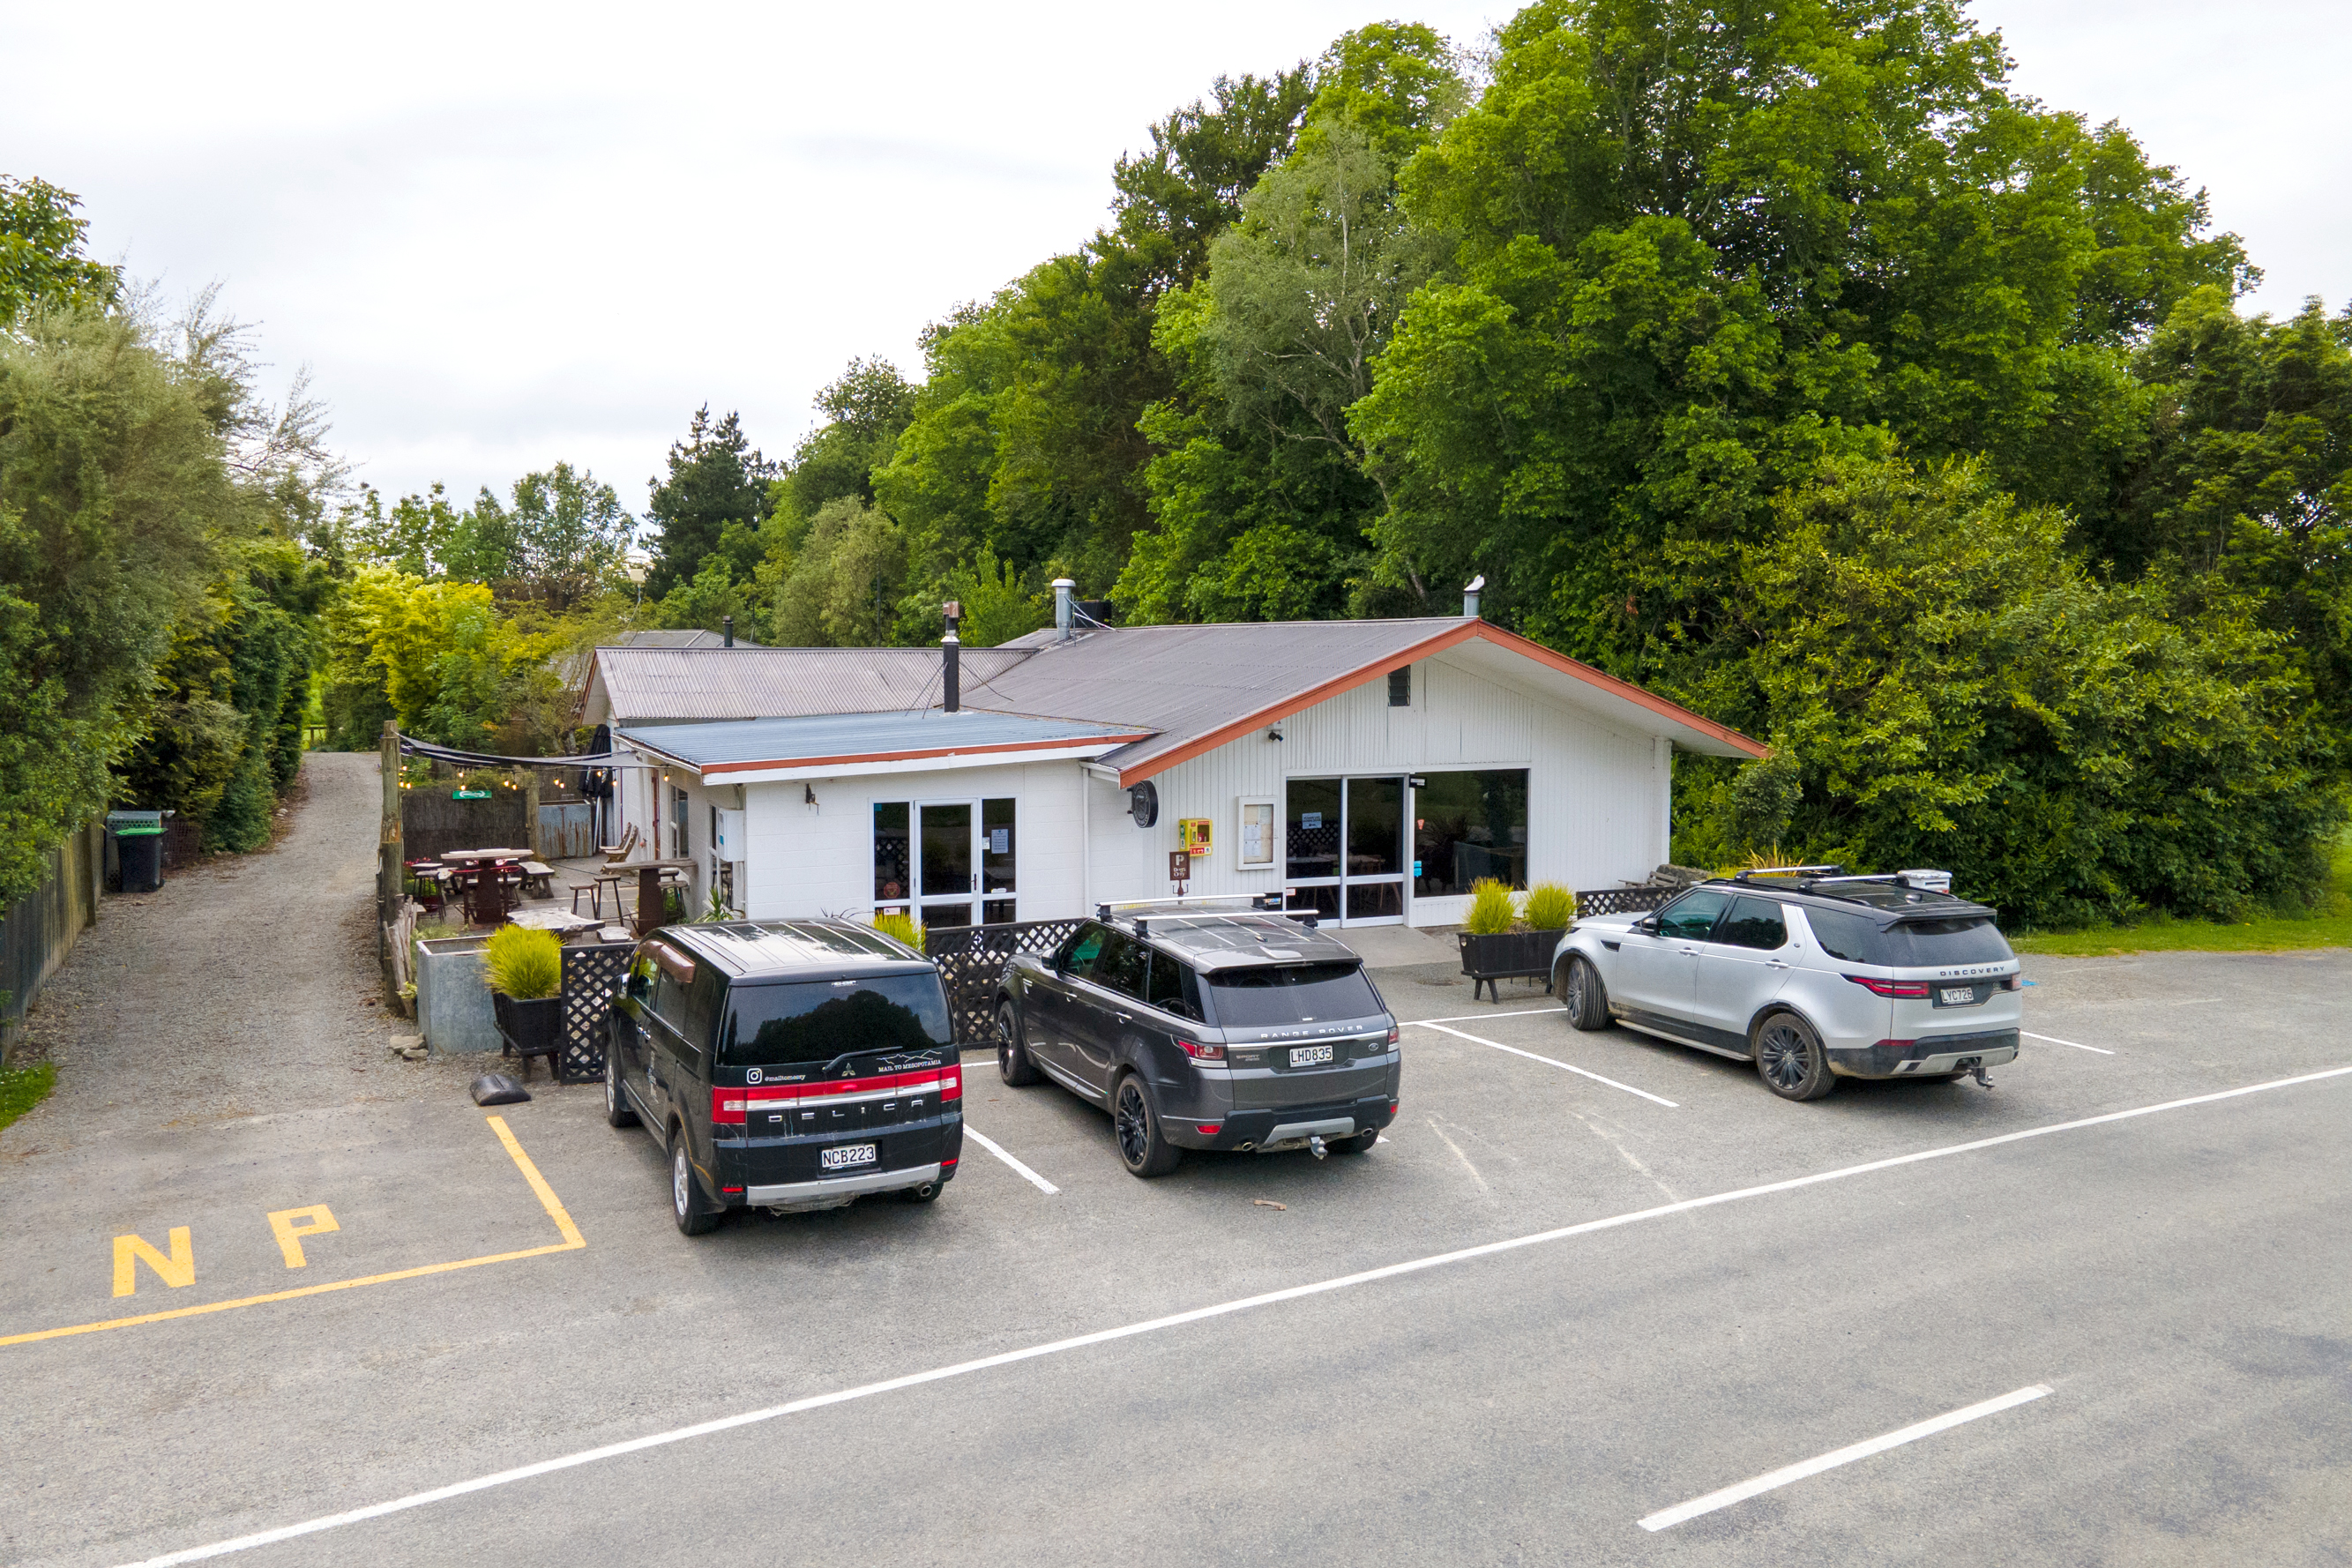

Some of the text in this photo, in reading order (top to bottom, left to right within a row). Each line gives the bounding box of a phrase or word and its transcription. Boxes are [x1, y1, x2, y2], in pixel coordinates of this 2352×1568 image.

[1176, 855, 1184, 866] P
[1940, 966, 2005, 976] DISCOVERY
[1941, 989, 1973, 1002] LYC726
[1260, 1025, 1363, 1039] RANGE ROVER
[1291, 1047, 1333, 1063] LHD835
[903, 1059, 942, 1070] MESOPOTAMIA
[768, 1099, 923, 1123] DELICA
[823, 1146, 875, 1167] NCB223
[112, 1204, 340, 1298] N P
